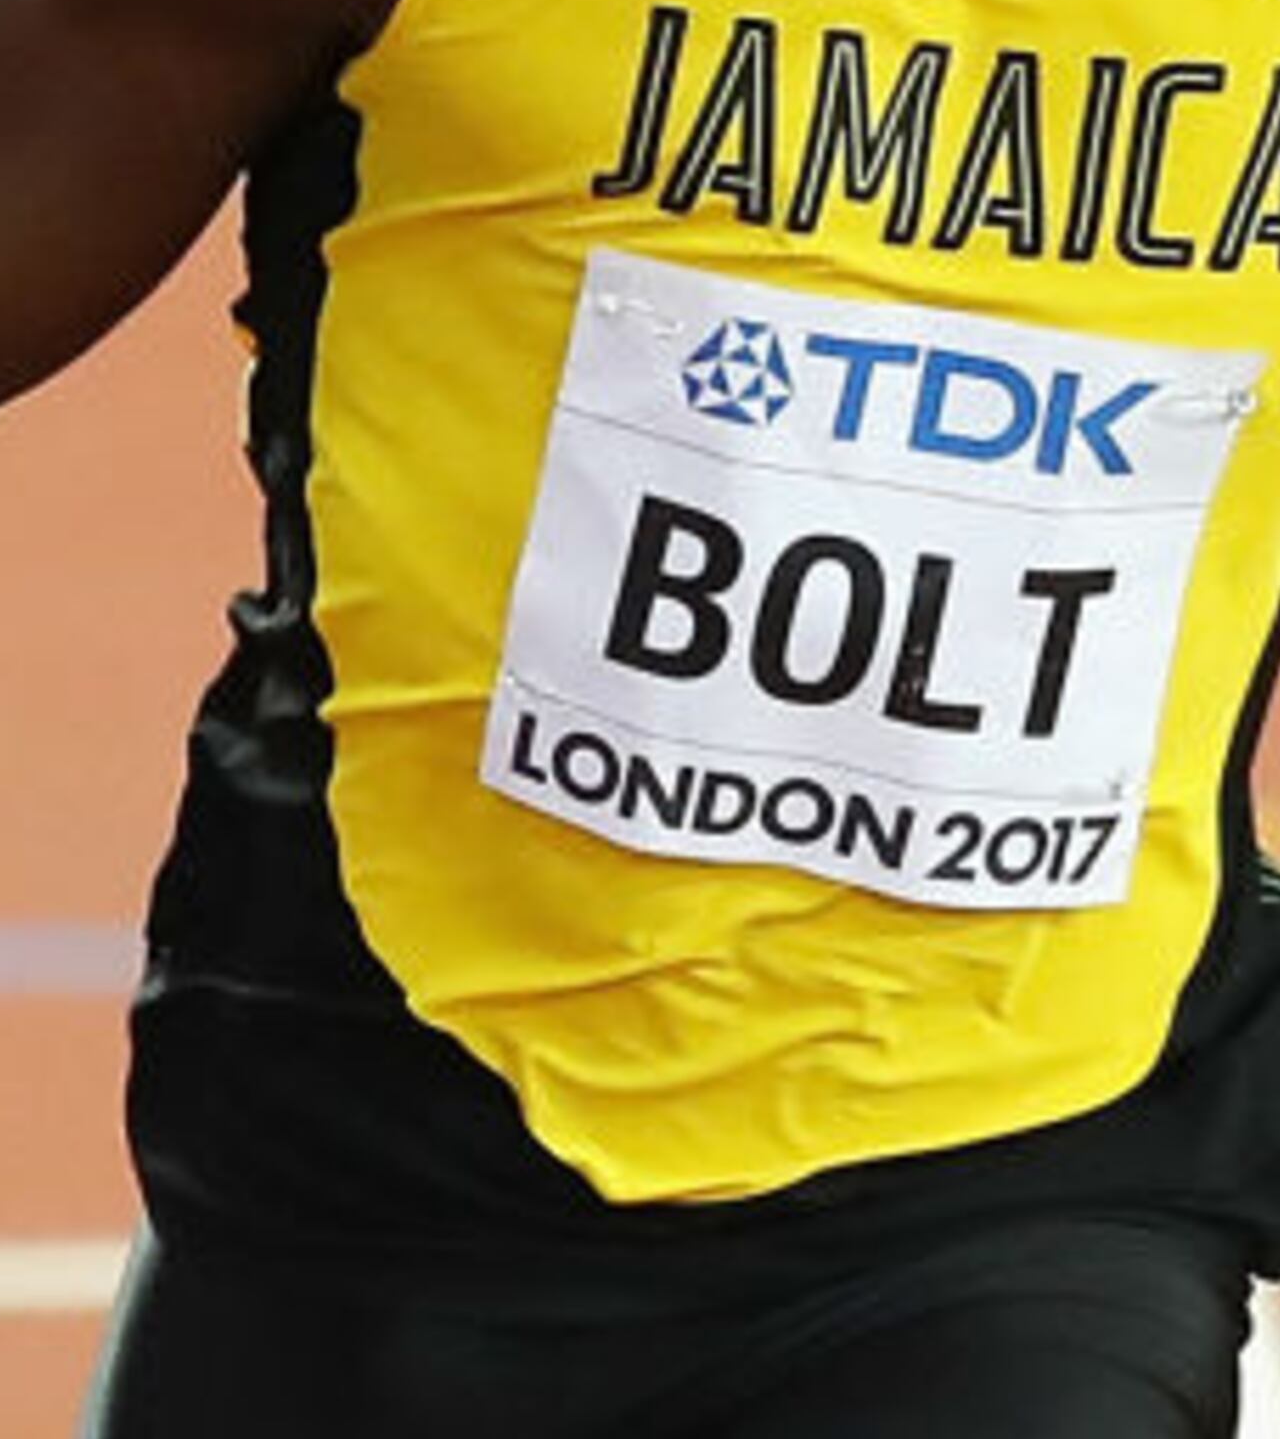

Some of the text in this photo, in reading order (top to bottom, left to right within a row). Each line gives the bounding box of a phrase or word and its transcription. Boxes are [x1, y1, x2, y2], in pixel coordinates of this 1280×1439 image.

[806, 331, 1162, 477] TDK
[602, 494, 1117, 738] BOLT
[510, 713, 1120, 887] LONDON 2017
